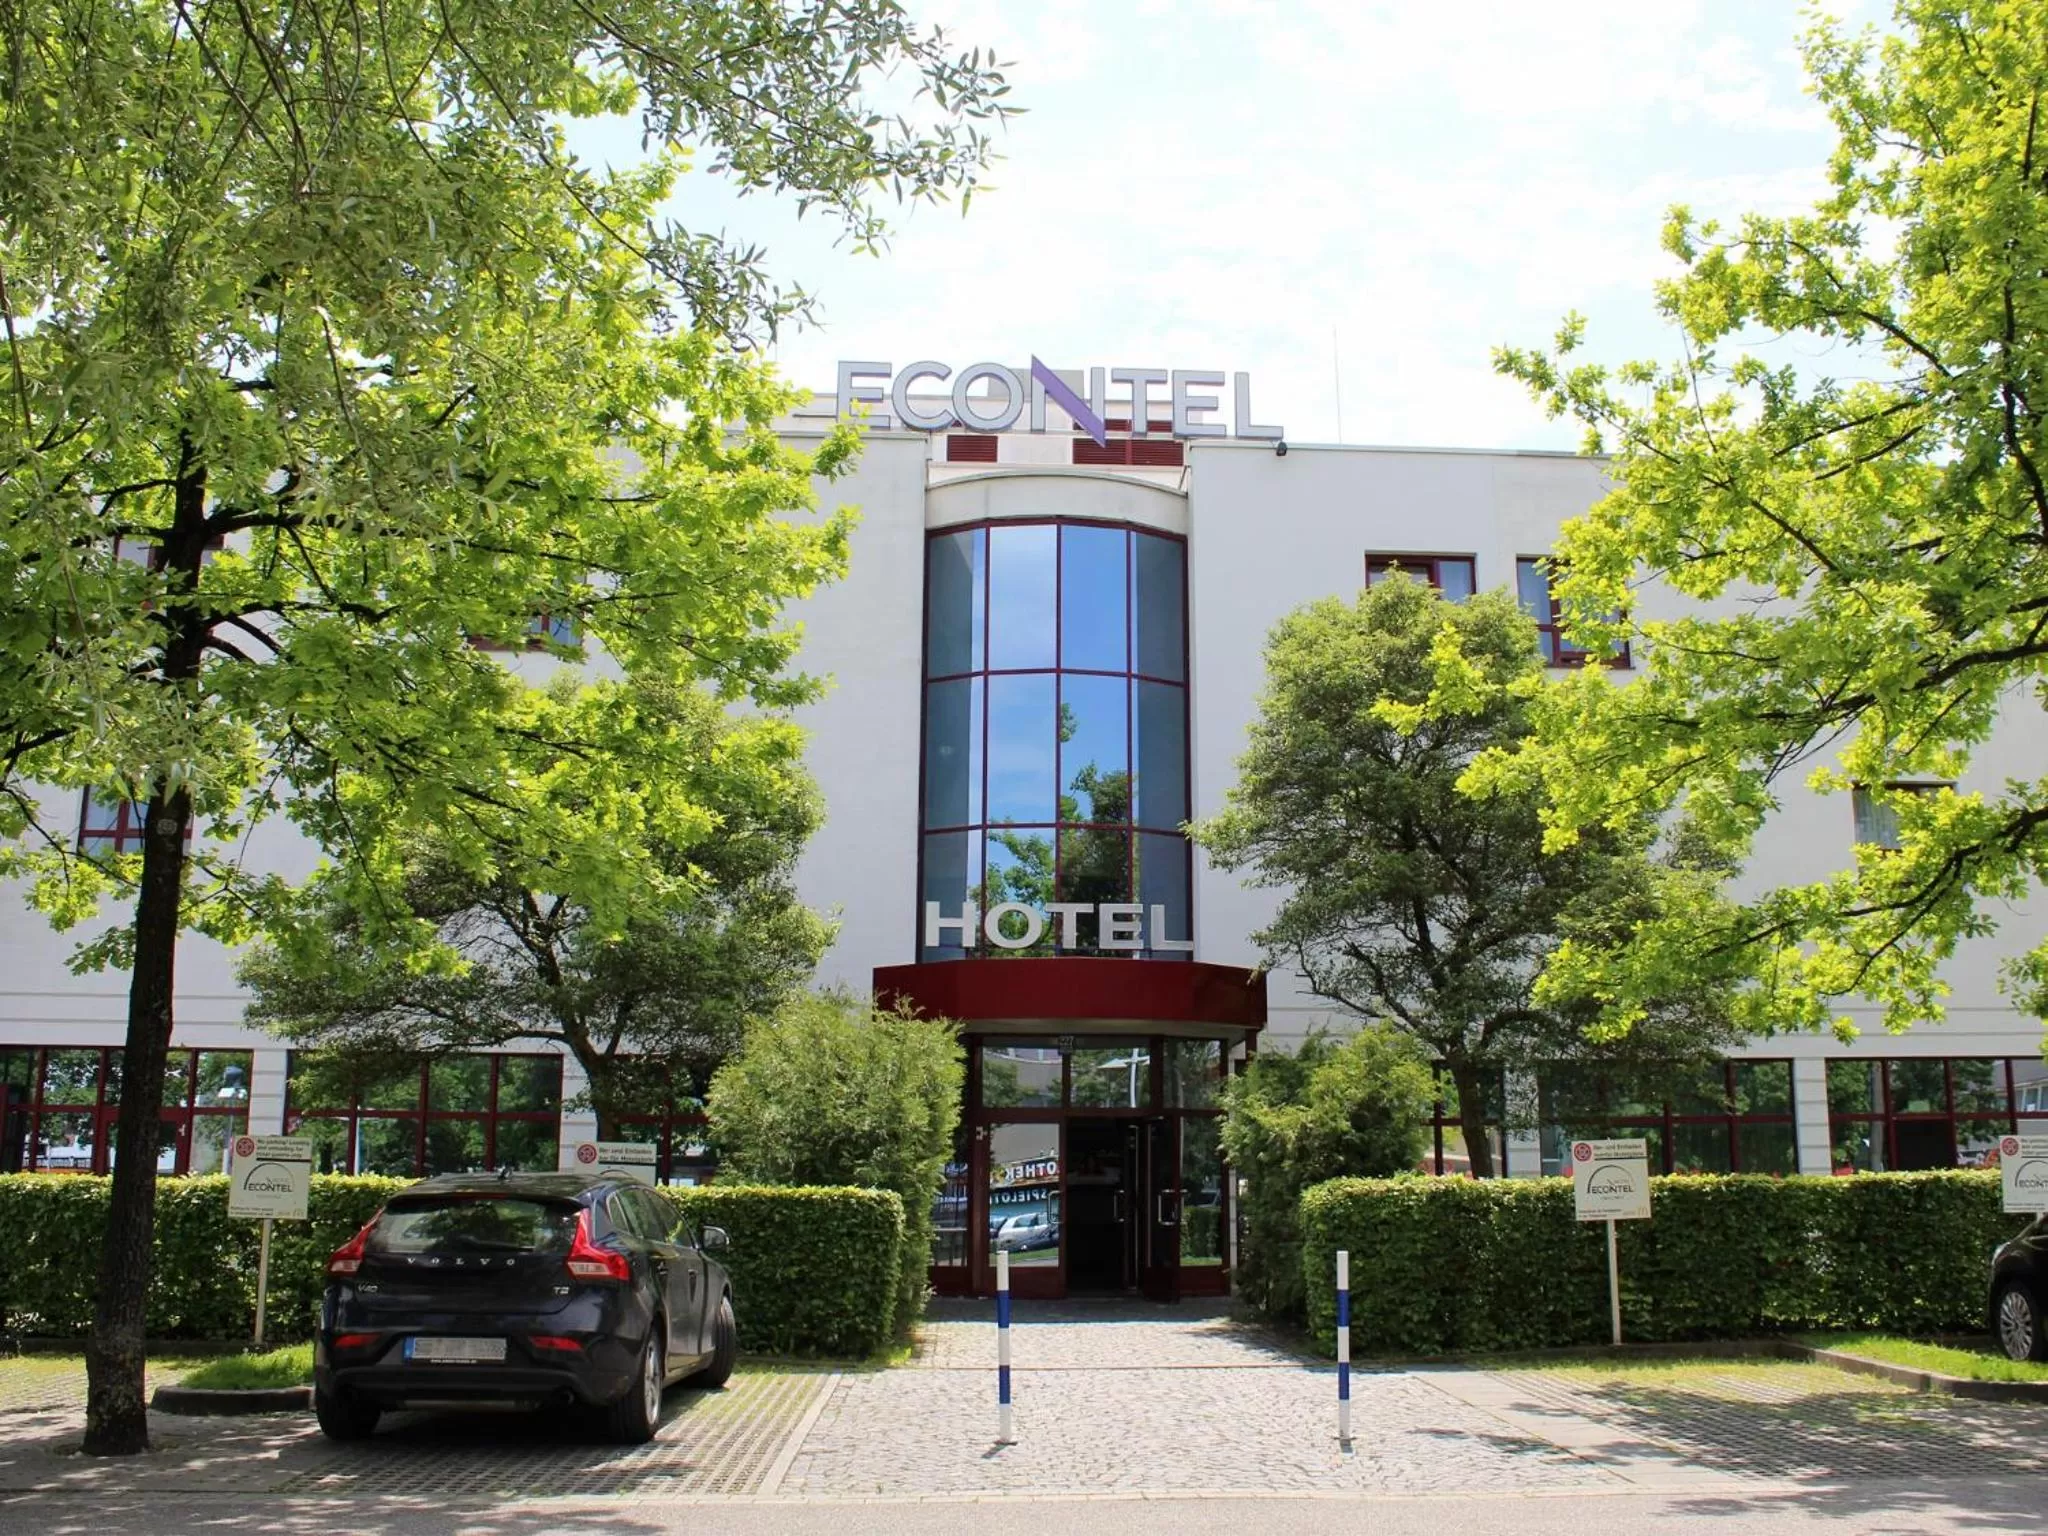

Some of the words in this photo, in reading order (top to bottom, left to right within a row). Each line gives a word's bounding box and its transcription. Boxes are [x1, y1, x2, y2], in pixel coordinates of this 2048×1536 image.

[836, 354, 1284, 448] ECONTEL
[925, 900, 1194, 950] HOTEL
[248, 1179, 293, 1193] ECONTEL
[1592, 1181, 1635, 1194] ECONTEL
[407, 1257, 515, 1265] VOLVO
